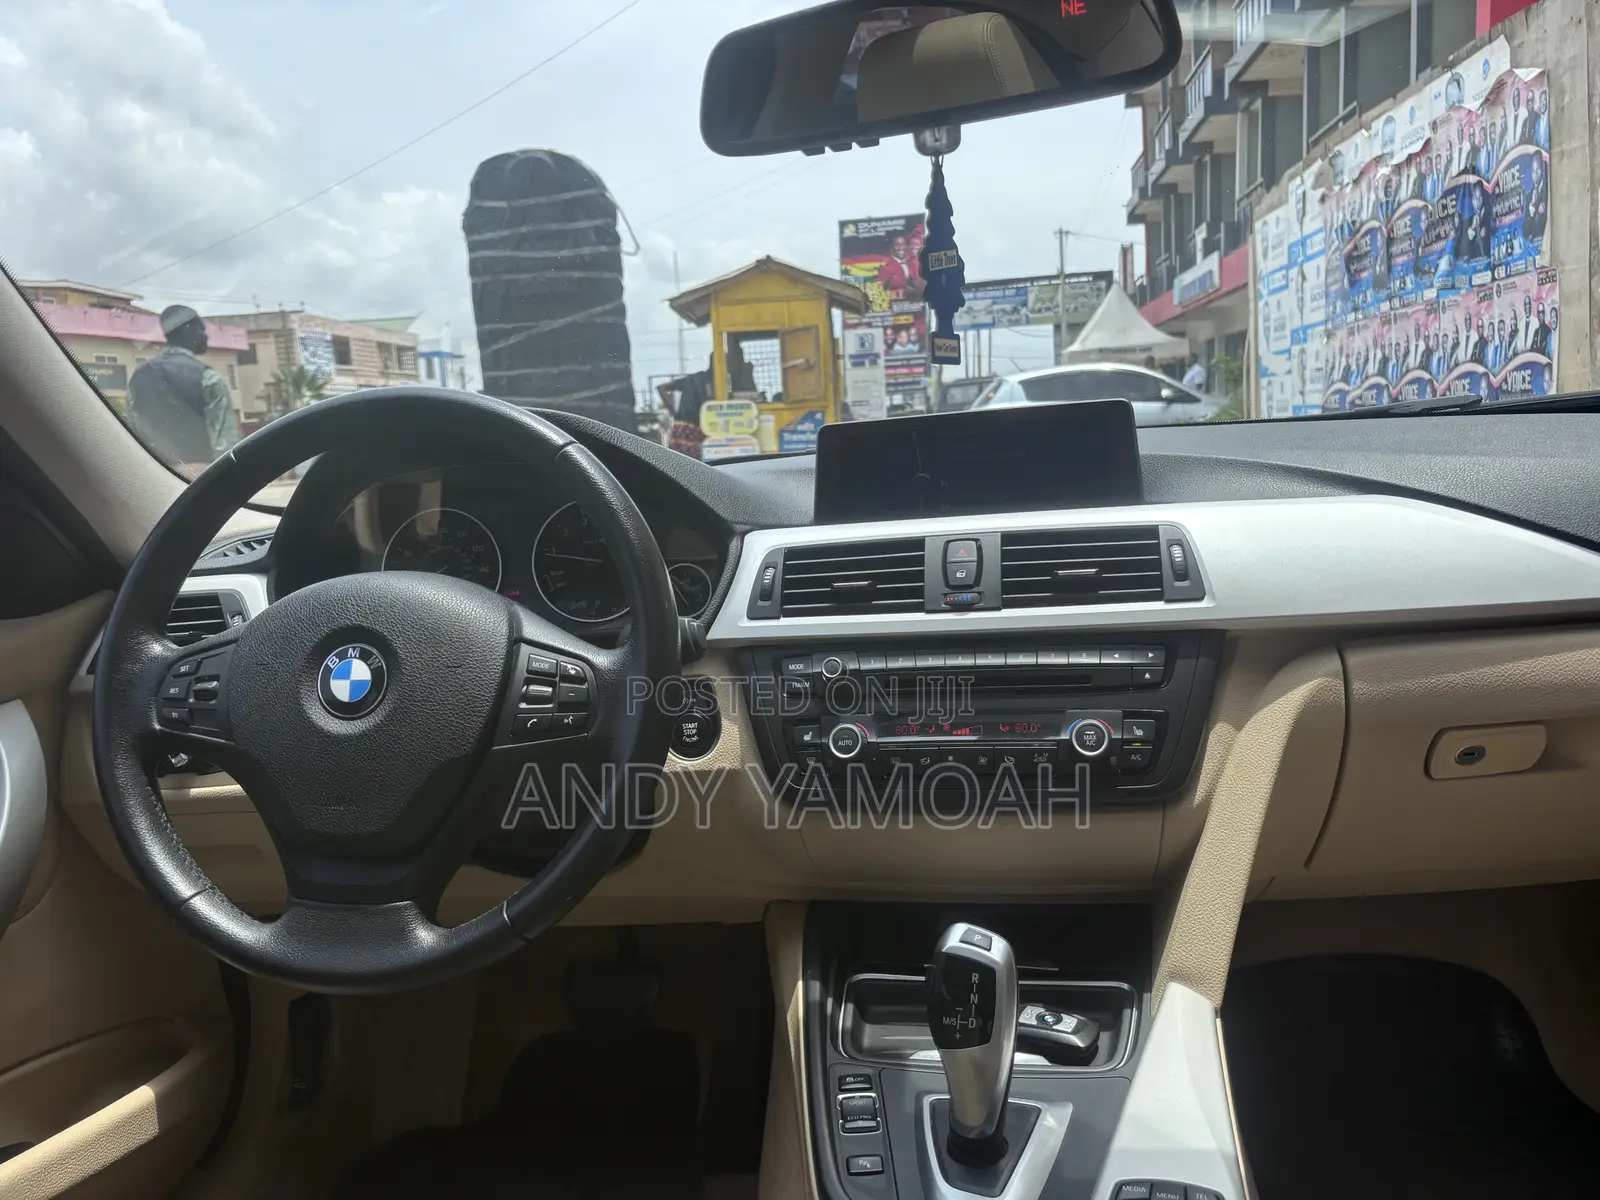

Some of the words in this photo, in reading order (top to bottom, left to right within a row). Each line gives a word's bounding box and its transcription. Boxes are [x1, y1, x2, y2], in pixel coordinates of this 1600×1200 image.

[1061, 0, 1087, 18] NE
[1506, 369, 1531, 393] VOICE
[327, 647, 381, 669] BMW
[180, 664, 189, 673] SET
[531, 661, 550, 669] MODE
[789, 663, 804, 671] MODE
[682, 722, 698, 730] START
[682, 735, 699, 743] ENGINE
[974, 934, 981, 942] P
[971, 973, 979, 984] R
[970, 993, 978, 1004] N
[942, 1017, 957, 1026] M/S
[968, 1018, 976, 1028] D
[1122, 1184, 1147, 1193] MEDIA
[1156, 1192, 1179, 1200] MENU
